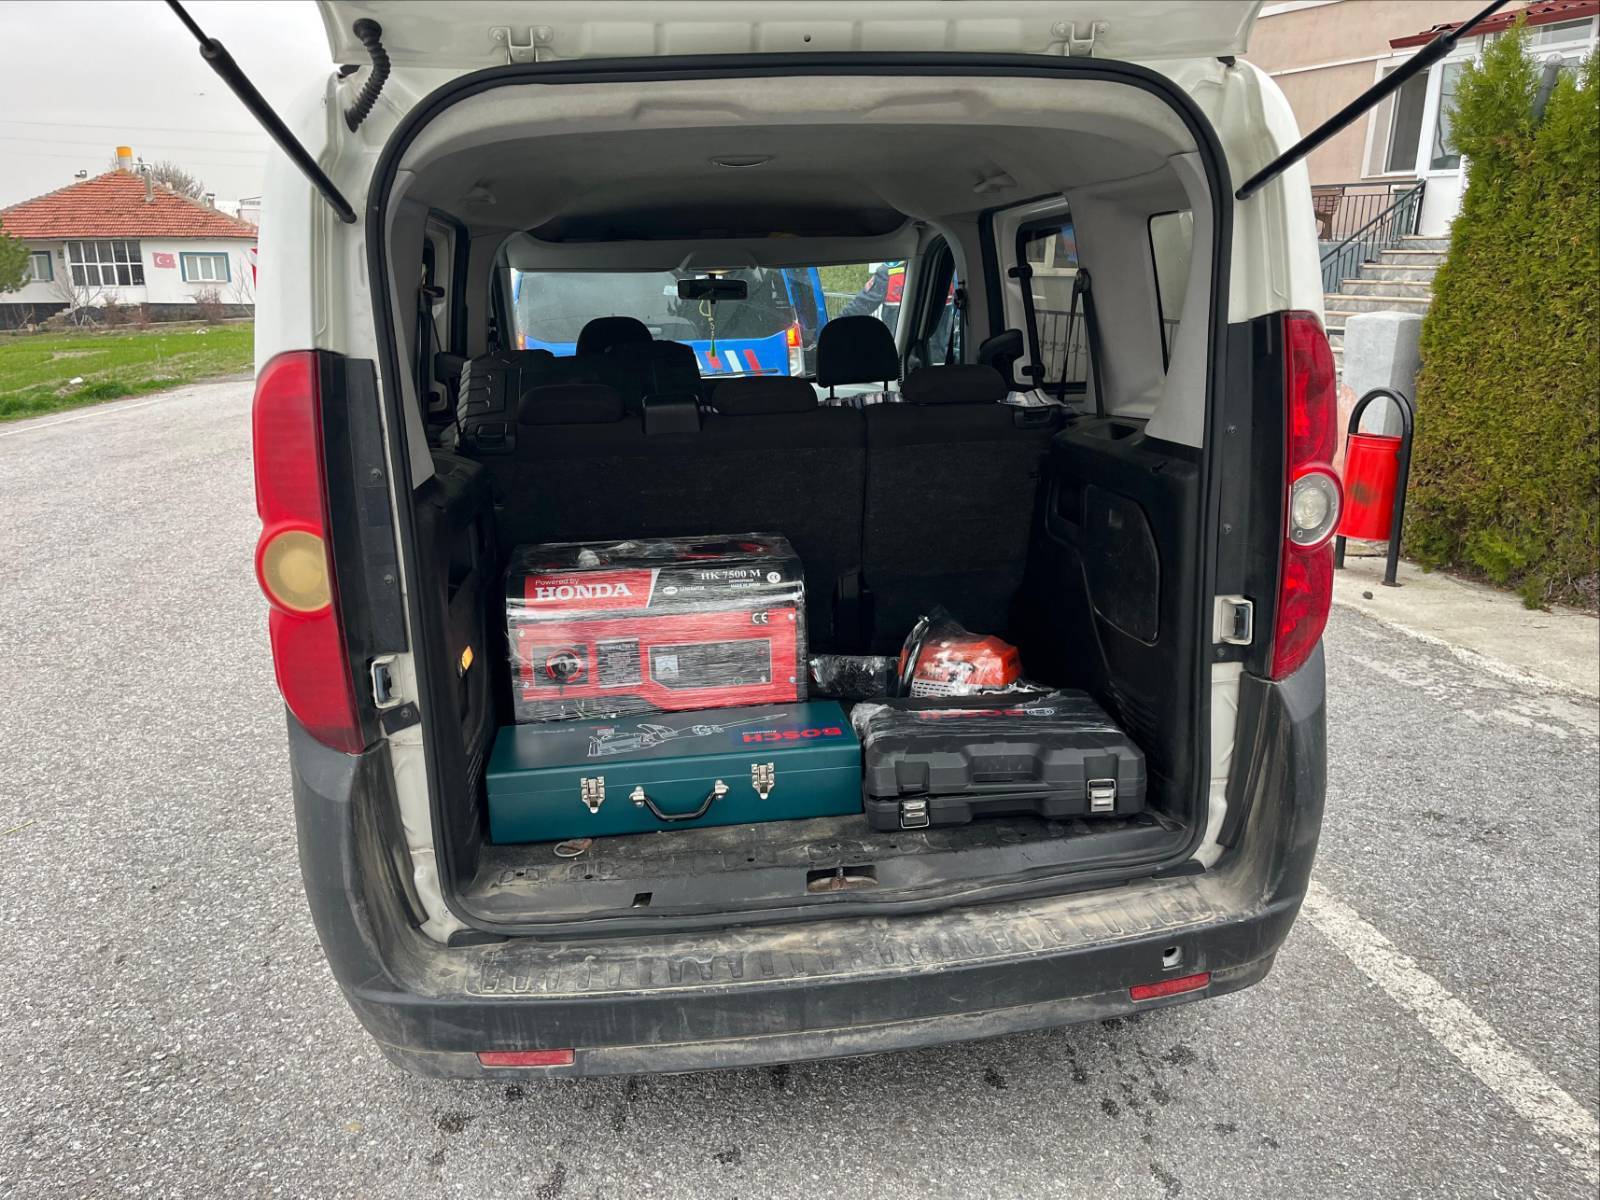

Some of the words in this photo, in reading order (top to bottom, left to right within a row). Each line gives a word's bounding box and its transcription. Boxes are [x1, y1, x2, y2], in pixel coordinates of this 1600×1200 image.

[701, 571, 720, 580] HK
[722, 570, 747, 579] 7500
[750, 569, 761, 577] M
[535, 578, 569, 586] Powered
[569, 577, 579, 585] by
[534, 583, 633, 601] HONDA
[752, 612, 768, 624] CE
[743, 727, 842, 743] BOSCH
